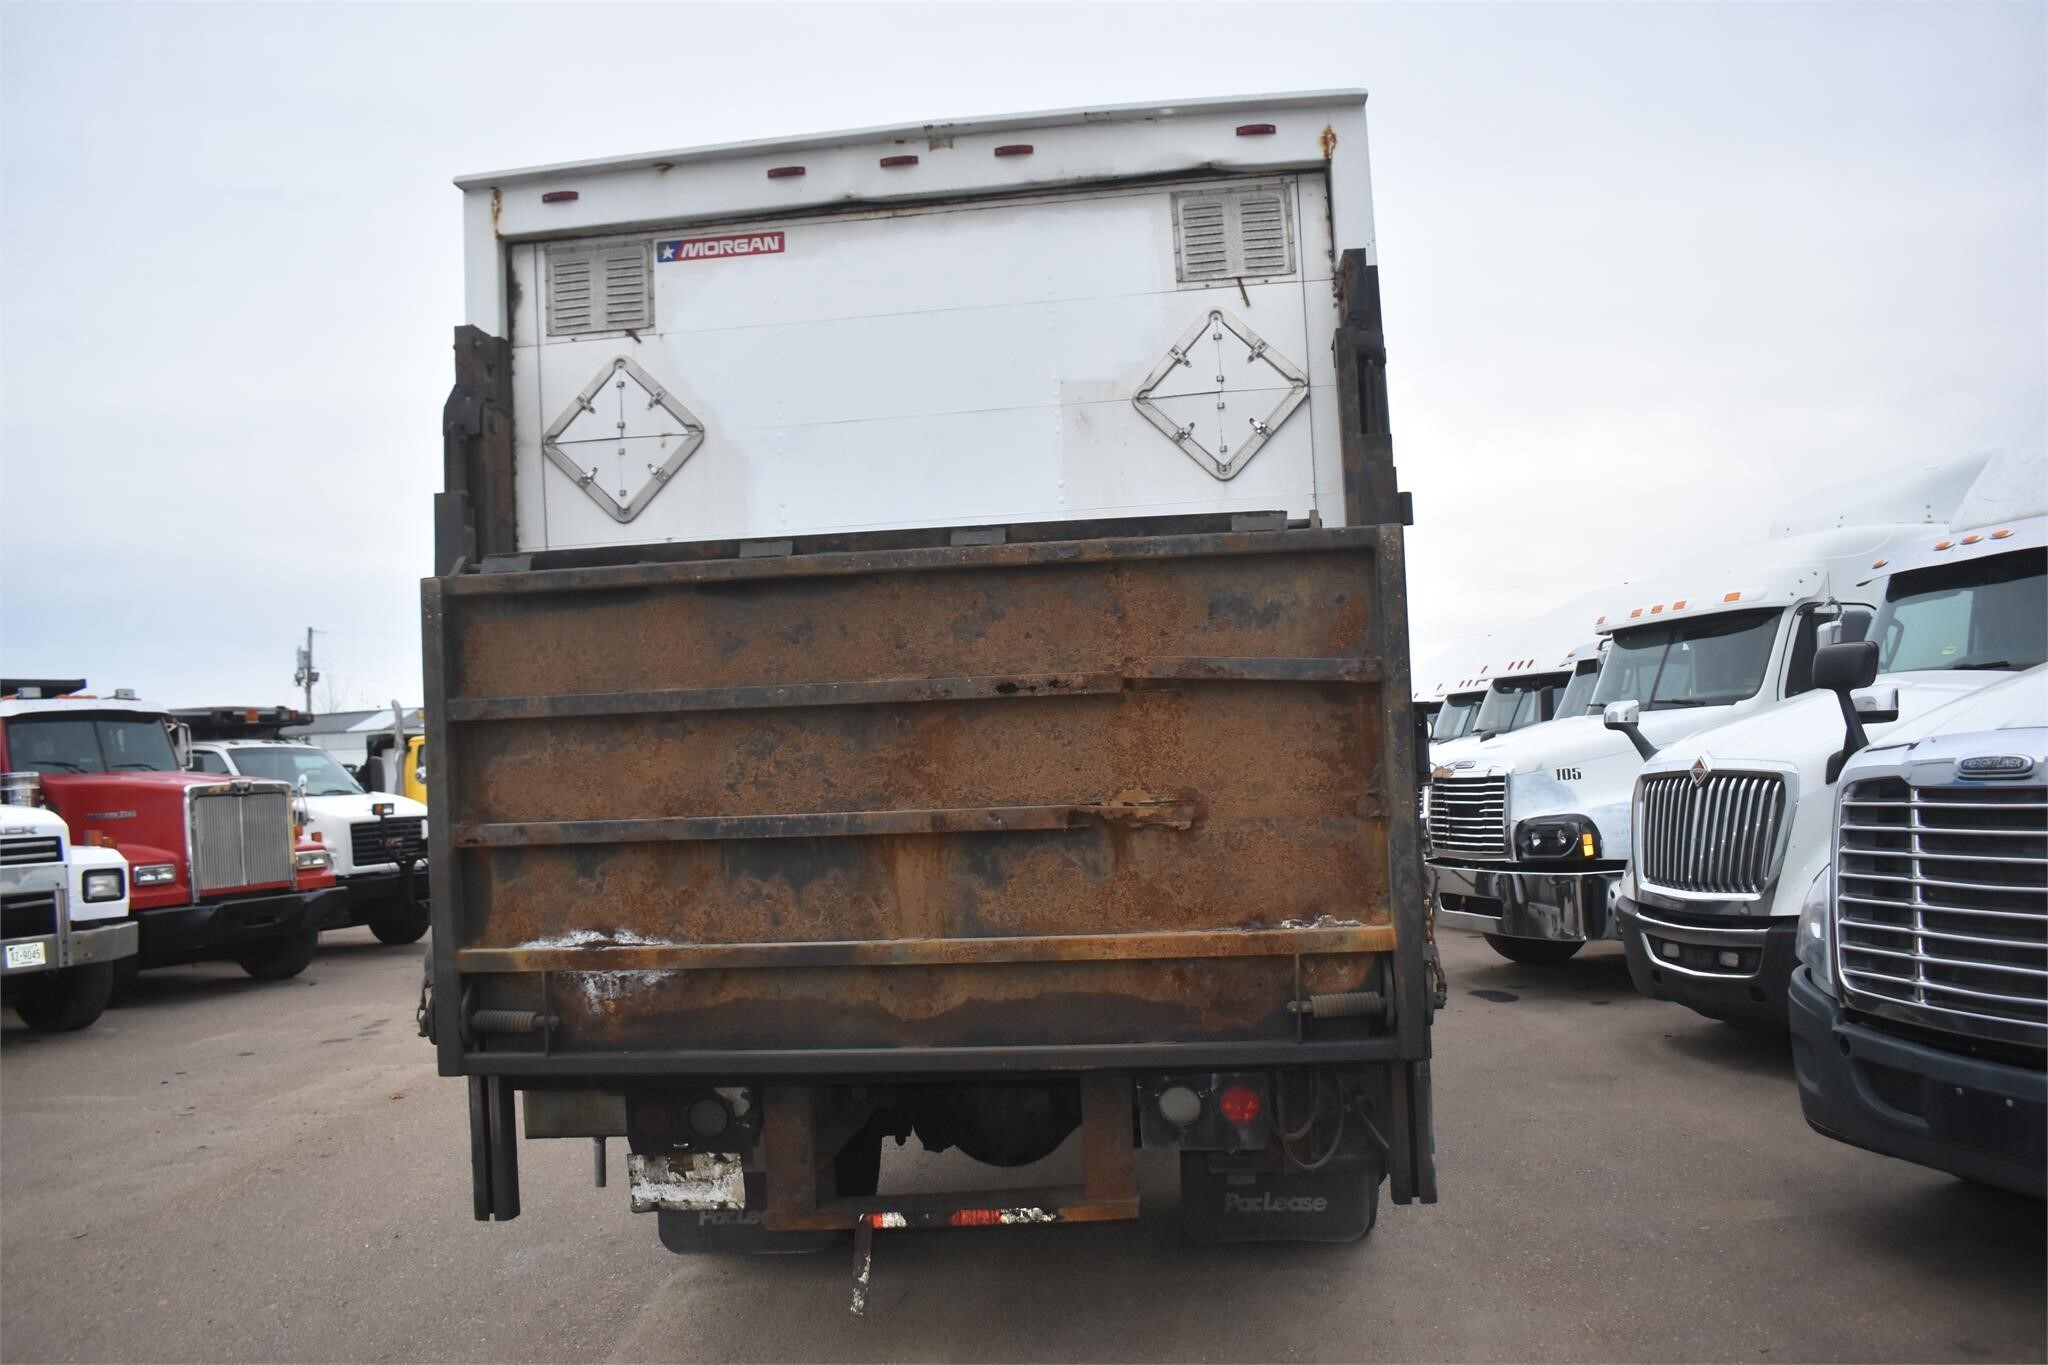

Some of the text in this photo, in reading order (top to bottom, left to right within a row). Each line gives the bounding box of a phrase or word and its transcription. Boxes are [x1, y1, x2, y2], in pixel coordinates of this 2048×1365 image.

[680, 236, 780, 258] MORGAN
[1963, 757, 2022, 769] FREIGHTLINER
[1556, 768, 1582, 781] 105
[1224, 1191, 1328, 1213] PacLease
[698, 1209, 768, 1226] PacLe
